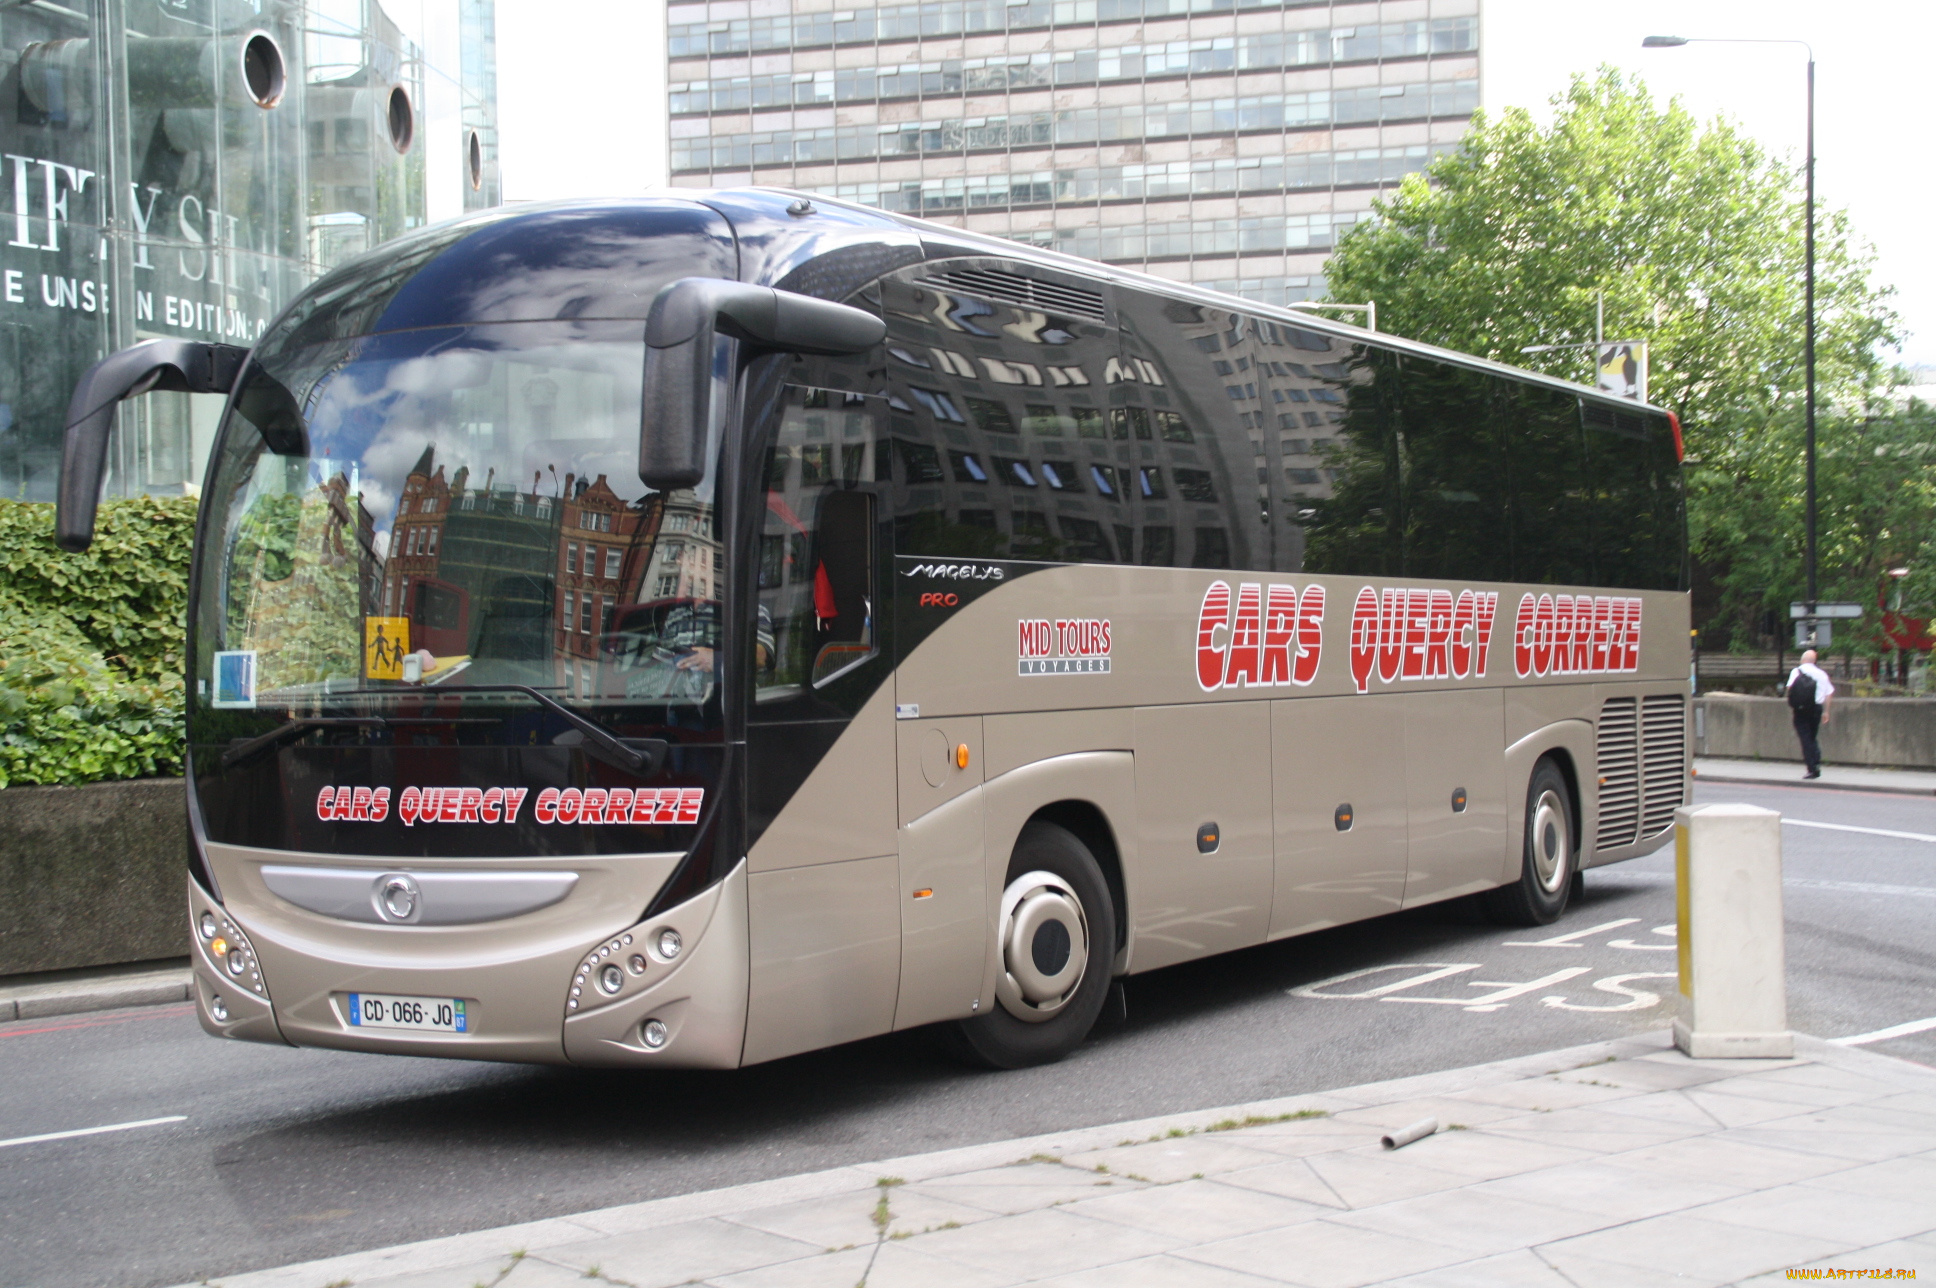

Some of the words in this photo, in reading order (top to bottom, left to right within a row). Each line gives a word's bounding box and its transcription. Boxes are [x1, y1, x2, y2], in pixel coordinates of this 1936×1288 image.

[41, 273, 154, 321] UNSEN
[900, 564, 1005, 580] MAGELYS
[919, 592, 959, 607] PRO
[1018, 618, 1053, 658] MID
[1055, 617, 1112, 657] TOURS
[1195, 580, 1326, 692] CARS
[1349, 585, 1498, 694] QUERCY
[1513, 592, 1643, 679] CORREZE
[1028, 659, 1105, 673] VOYAGES
[316, 786, 391, 822] CARS
[399, 786, 528, 826] QUERCY
[535, 787, 704, 825] CORREZE
